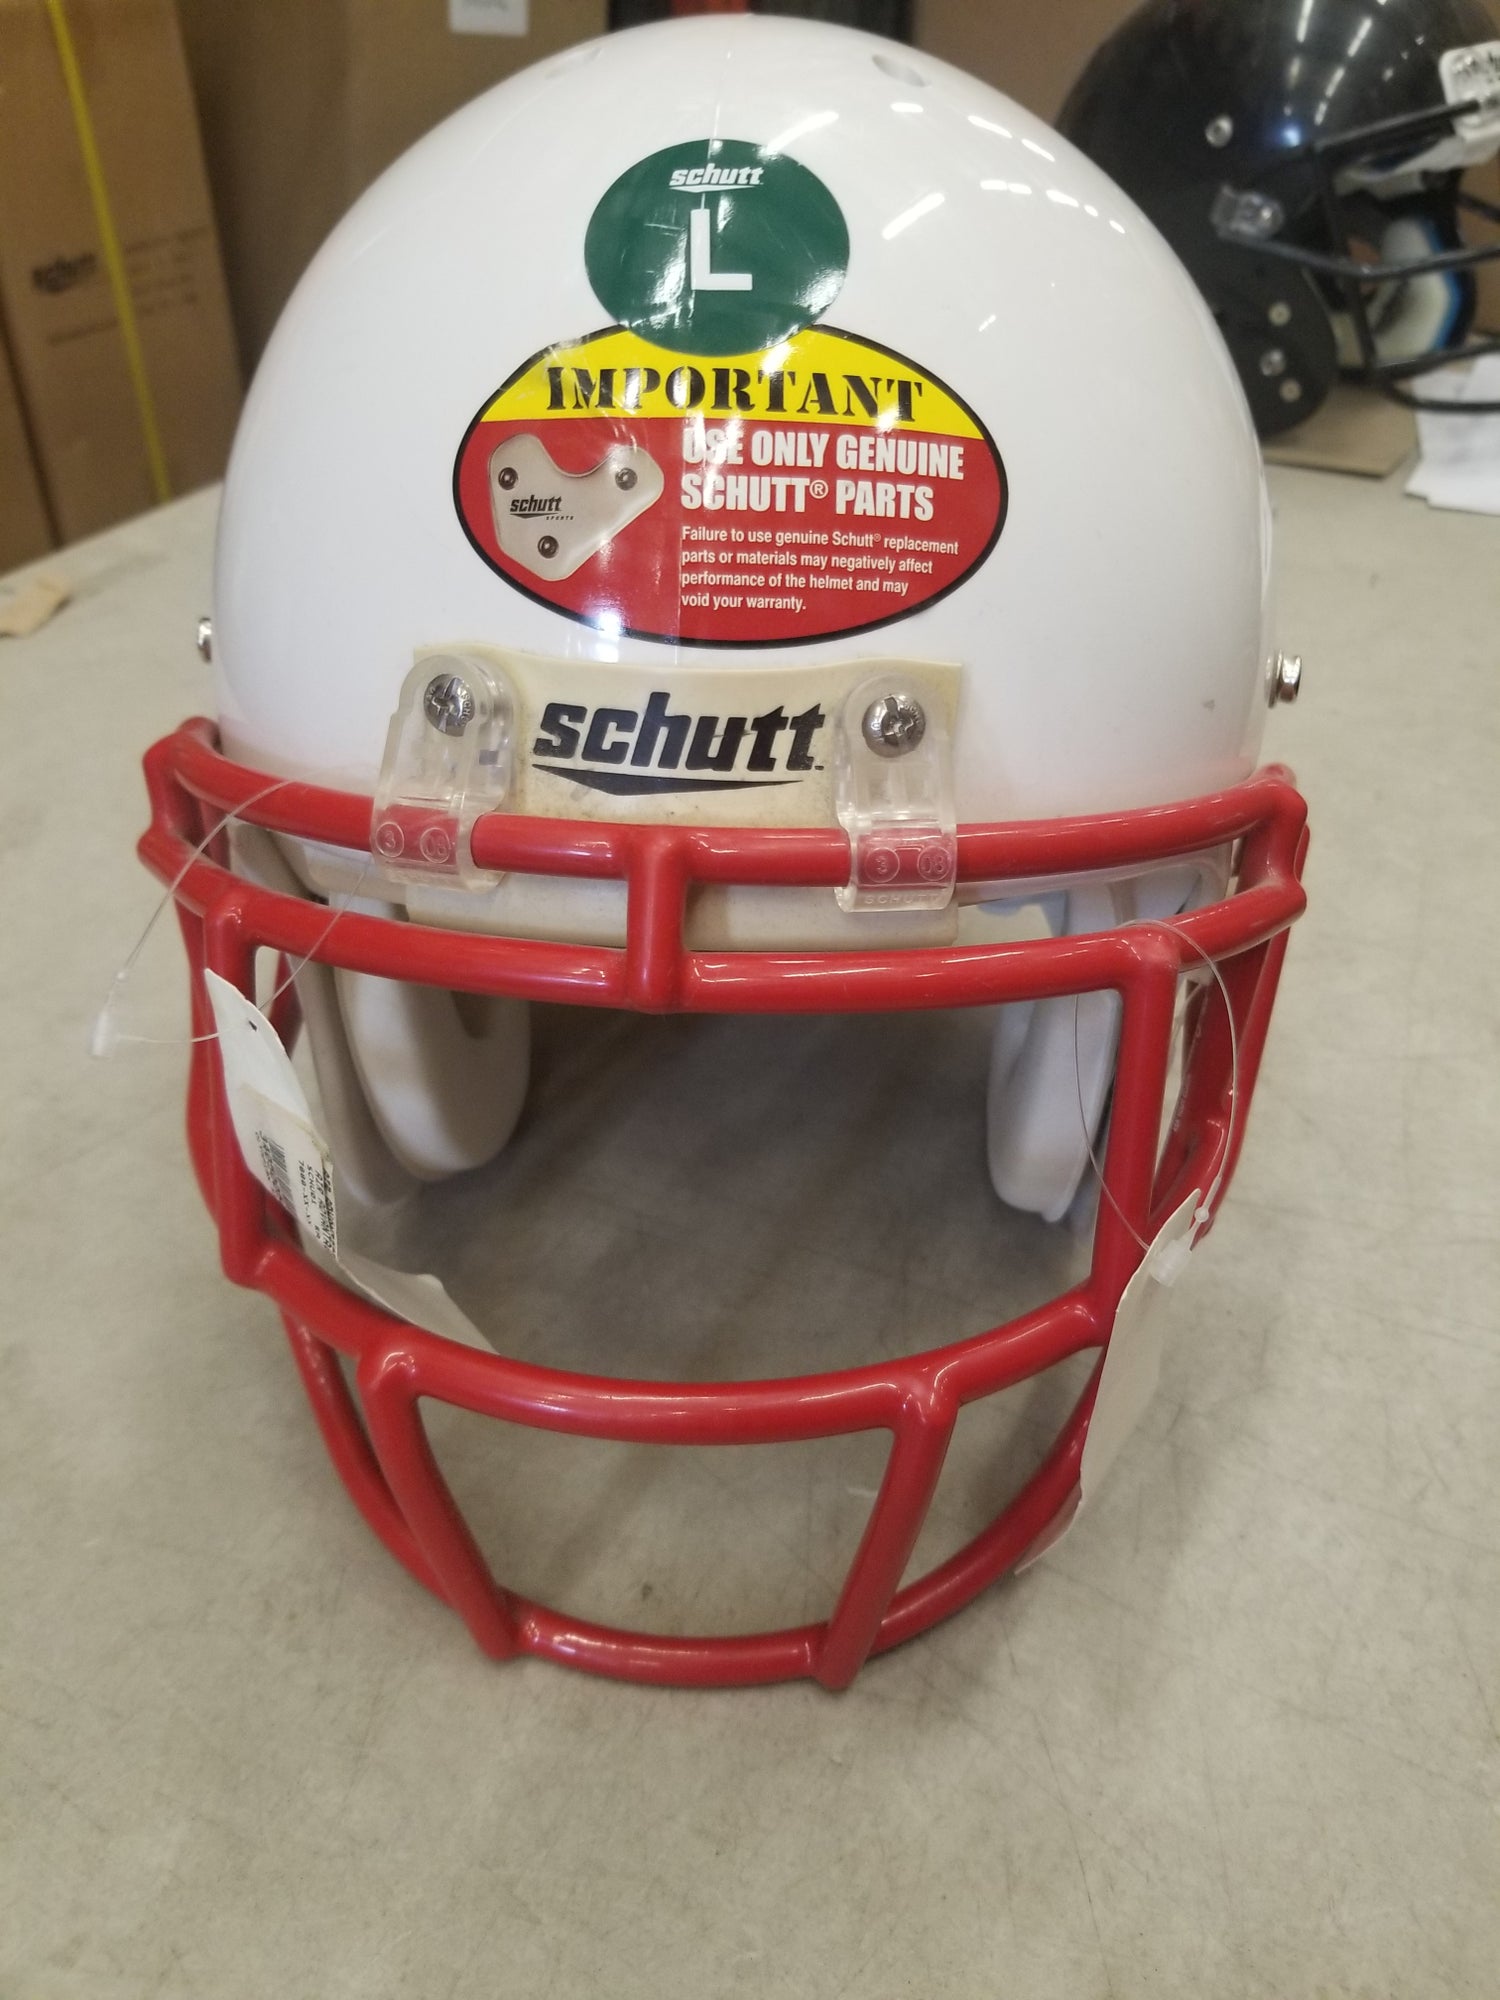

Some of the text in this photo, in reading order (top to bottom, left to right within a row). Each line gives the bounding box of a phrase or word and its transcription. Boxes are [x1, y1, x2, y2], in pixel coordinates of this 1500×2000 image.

[669, 163, 763, 186] schutt
[691, 209, 752, 290] L
[546, 366, 923, 422] IMPORTANT
[682, 427, 965, 480] USE ONLY GENUINE
[510, 494, 562, 512] schutt
[835, 479, 934, 521] PARTS
[682, 526, 728, 541] Failure
[731, 528, 744, 542] to
[748, 530, 772, 543] use
[776, 530, 828, 546] genuine
[884, 536, 959, 555] replacement
[682, 550, 933, 574] parts or materials may negatively affect
[682, 571, 908, 597] performance of the helmet and may
[682, 592, 806, 613] void your warranty.
[532, 692, 825, 772] schutt
